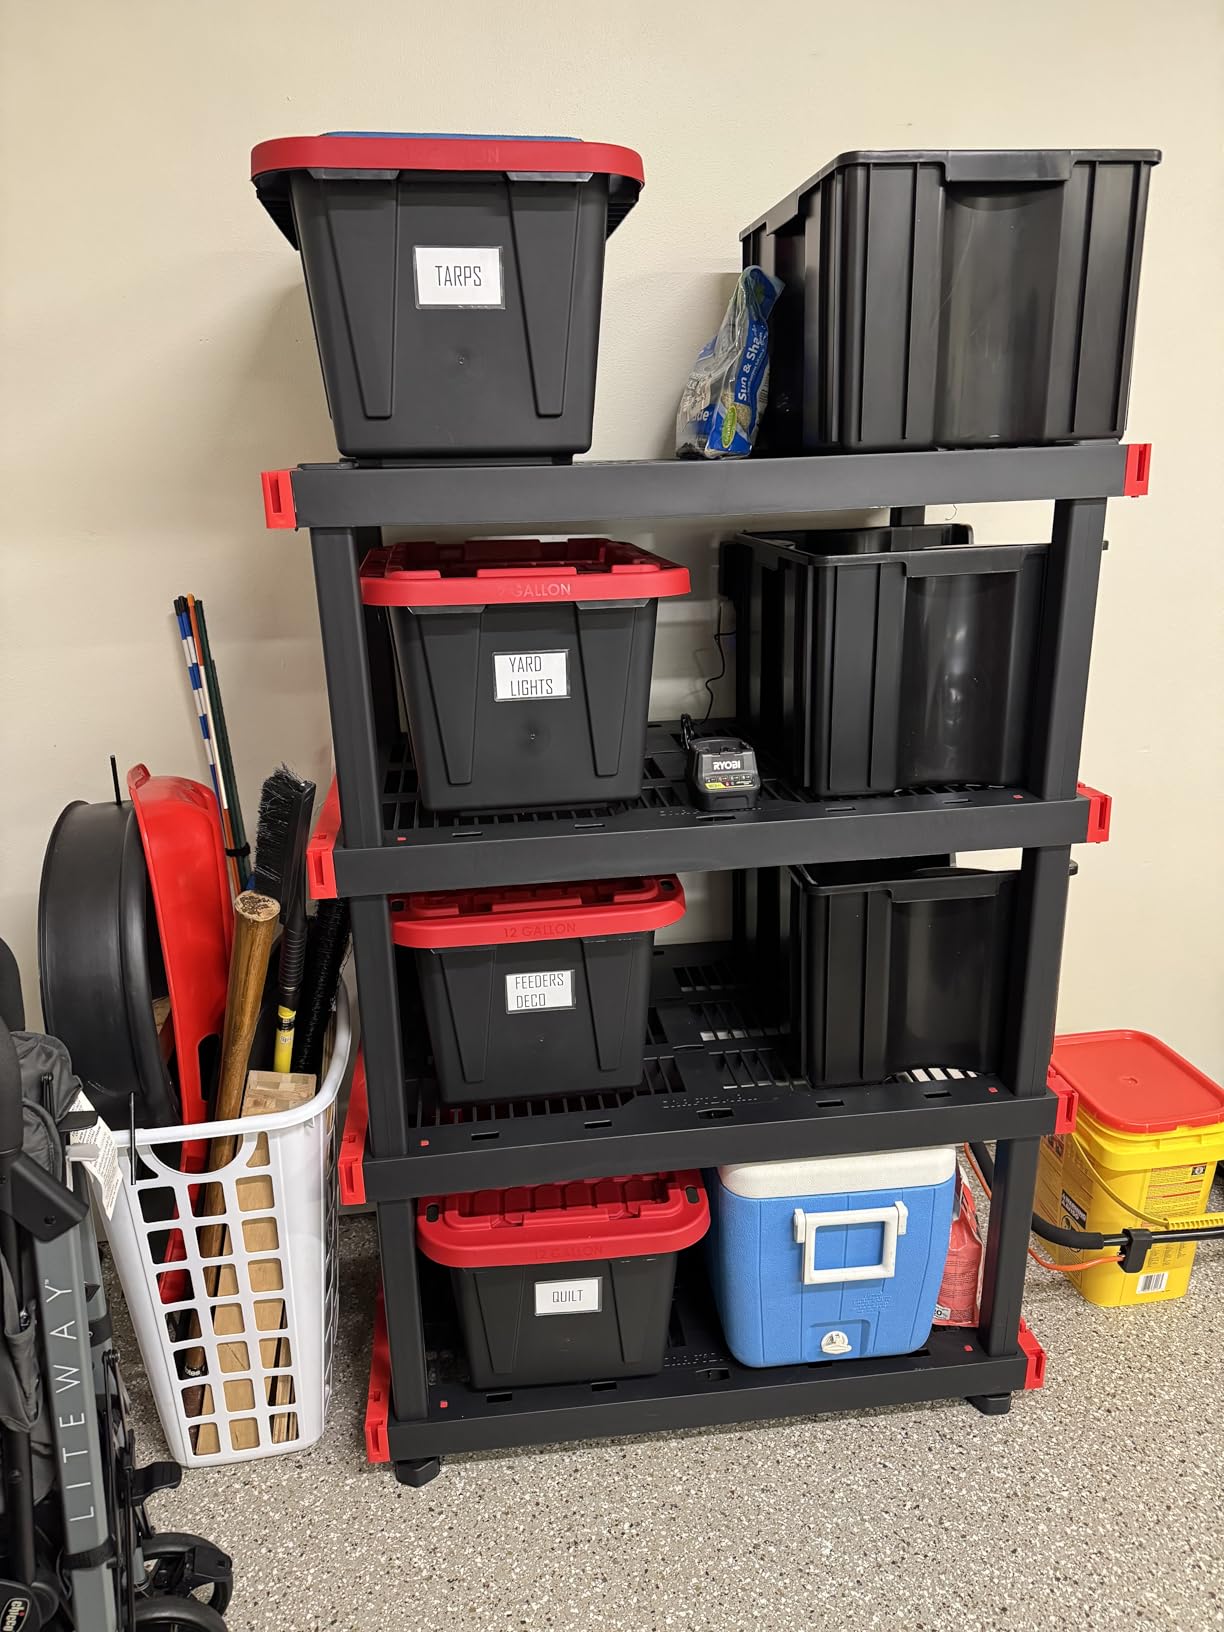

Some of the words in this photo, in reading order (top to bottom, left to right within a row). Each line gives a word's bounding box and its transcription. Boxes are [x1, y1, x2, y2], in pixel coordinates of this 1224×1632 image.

[434, 265, 482, 287] TARPS
[742, 363, 752, 374] &
[737, 377, 748, 401] Sun
[512, 583, 571, 597] GALLON
[508, 656, 542, 672] YARD
[510, 679, 553, 696] LIGHTS
[712, 760, 741, 771] RYOBI
[504, 927, 517, 938] 12
[521, 920, 576, 937] GALLON
[515, 973, 564, 990] FEEDERS
[516, 993, 546, 1008] DECO
[552, 1289, 583, 1303] QUILT
[2, 1600, 25, 1632] chicco
